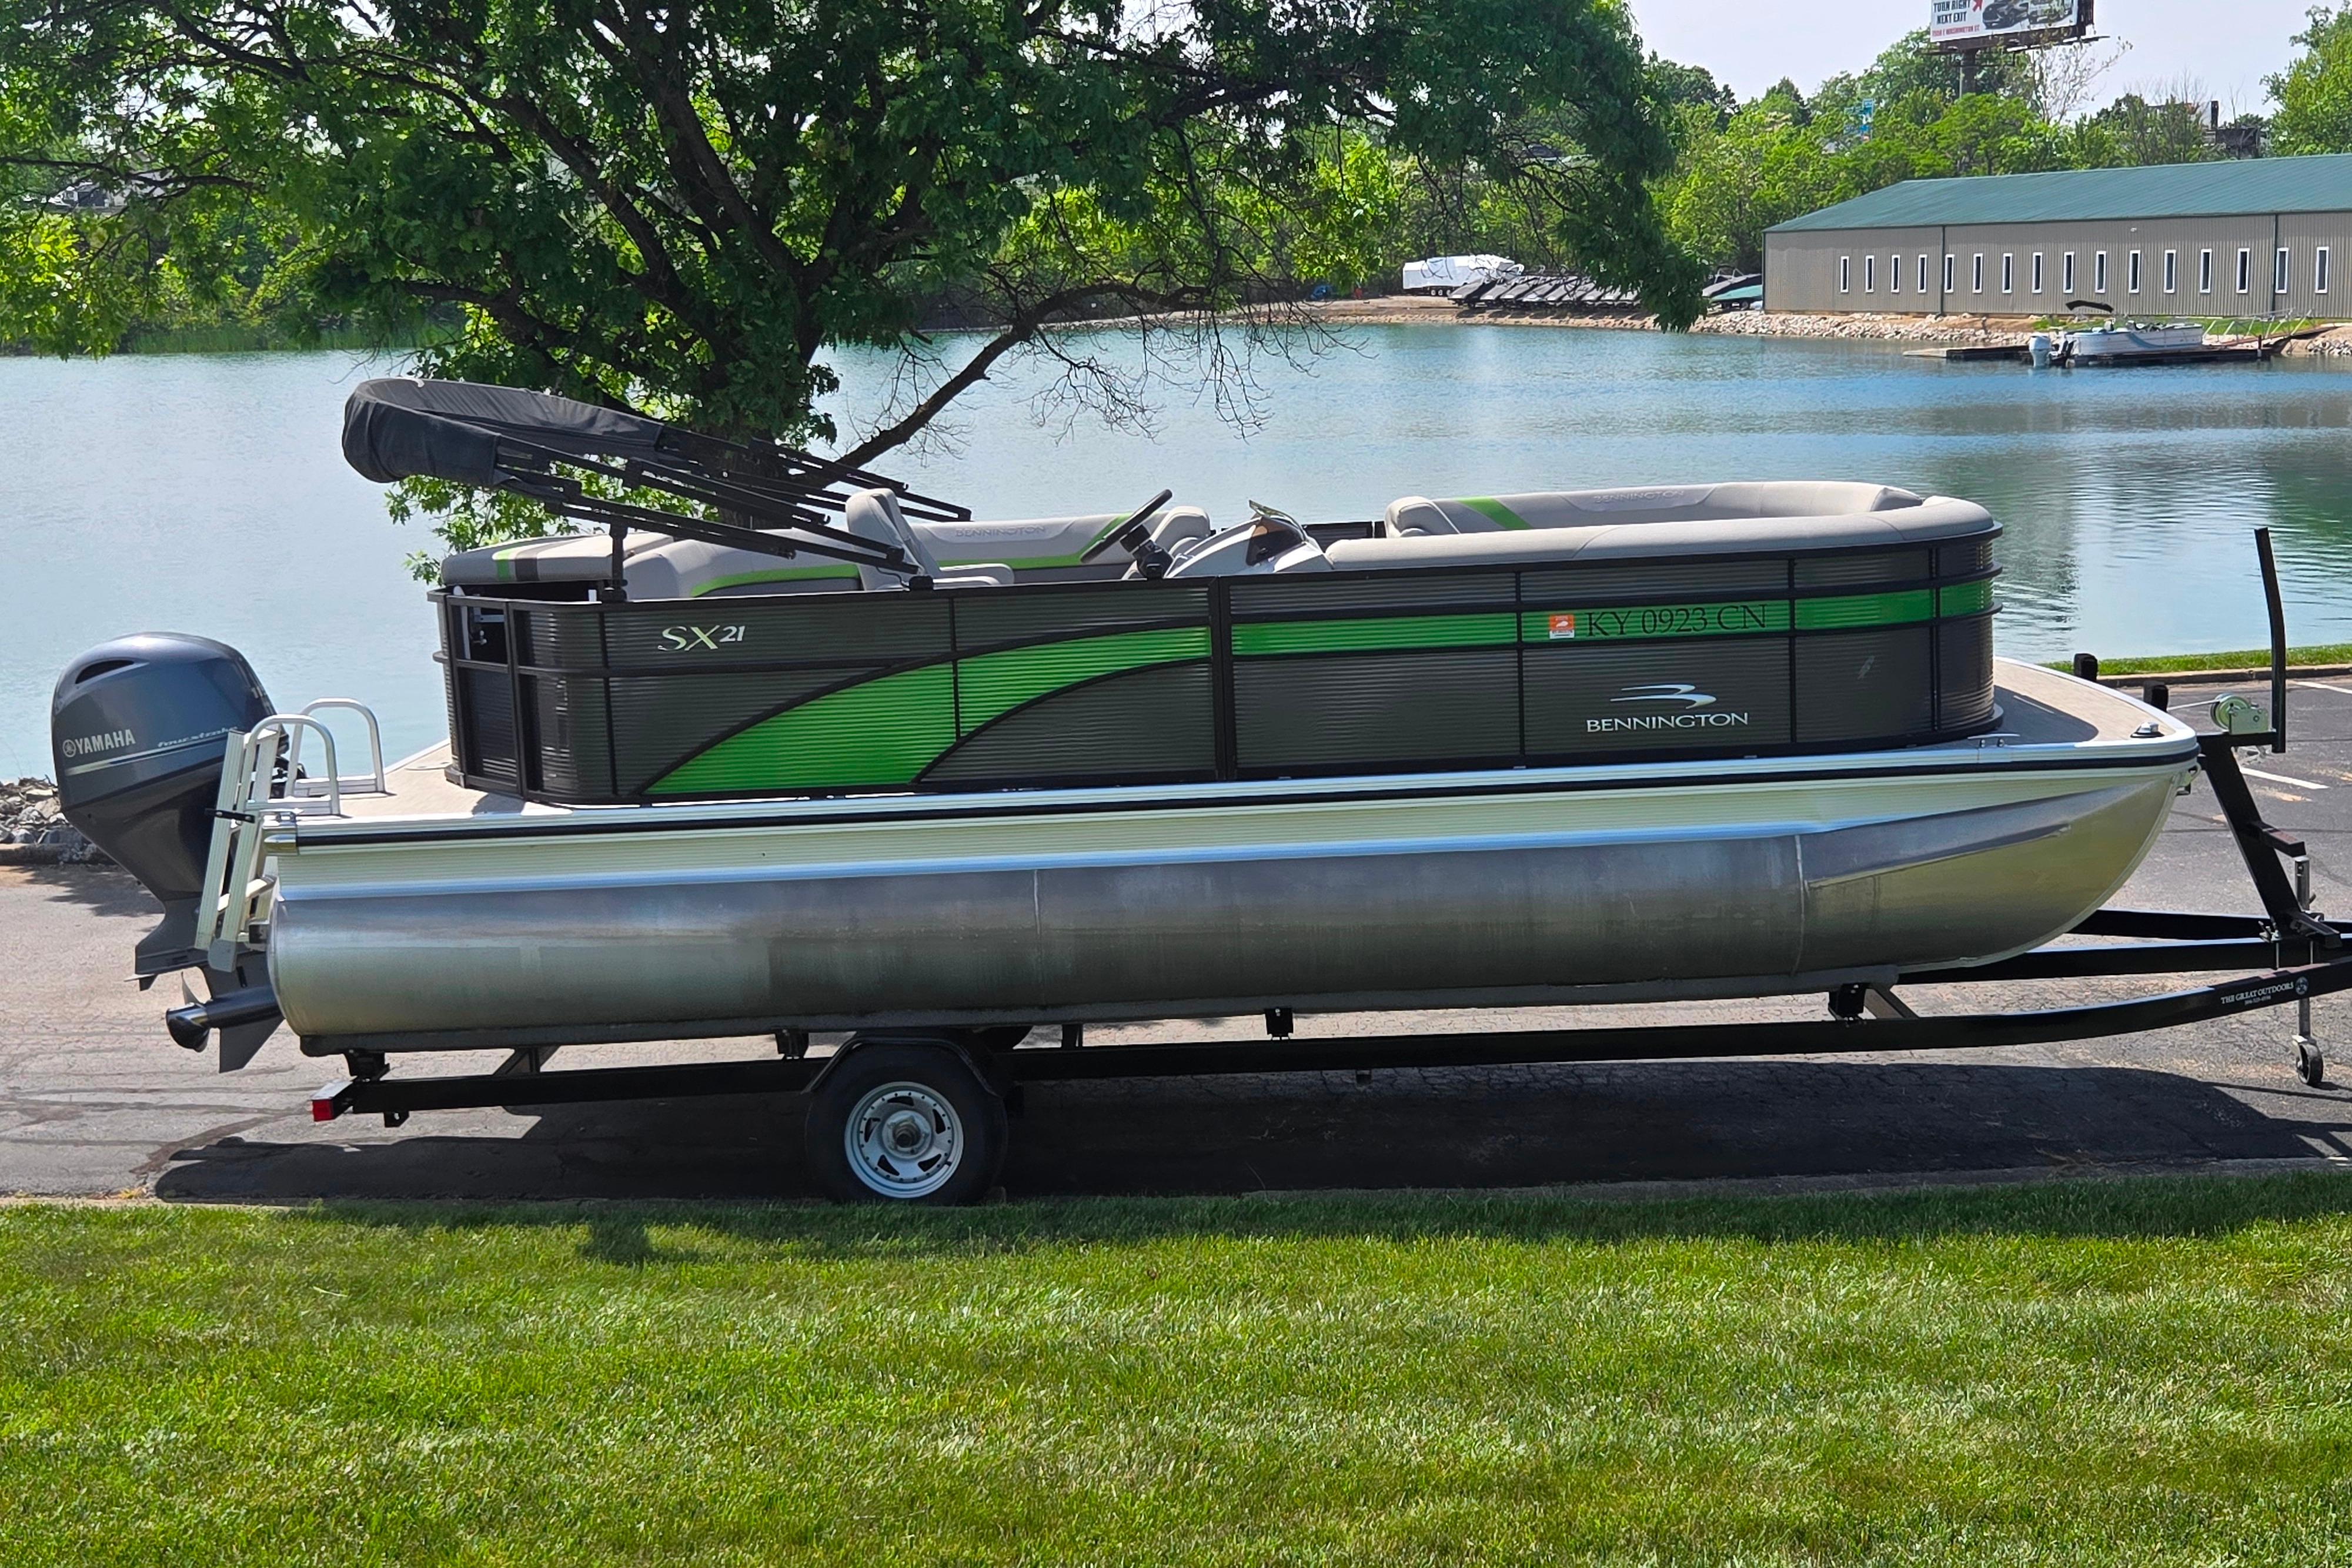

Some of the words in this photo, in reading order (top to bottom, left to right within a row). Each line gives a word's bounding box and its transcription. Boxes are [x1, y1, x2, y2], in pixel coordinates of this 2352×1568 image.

[1933, 1, 1950, 12] TURN
[1937, 13, 1952, 24] NEXT
[1953, 11, 1967, 22] EXIT
[1594, 490, 1684, 503] BENNINGTON
[956, 526, 1046, 537] BENNINGTON
[1586, 610, 1632, 636] KY
[1642, 607, 1707, 634] 0923
[1717, 604, 1767, 630] CN
[1587, 713, 1748, 733] BENNINGTON
[75, 729, 136, 754] YAMAHA
[2221, 995, 2235, 1004] THE
[2235, 990, 2257, 1001] GREAT
[2258, 982, 2294, 996] OUTDOORS
